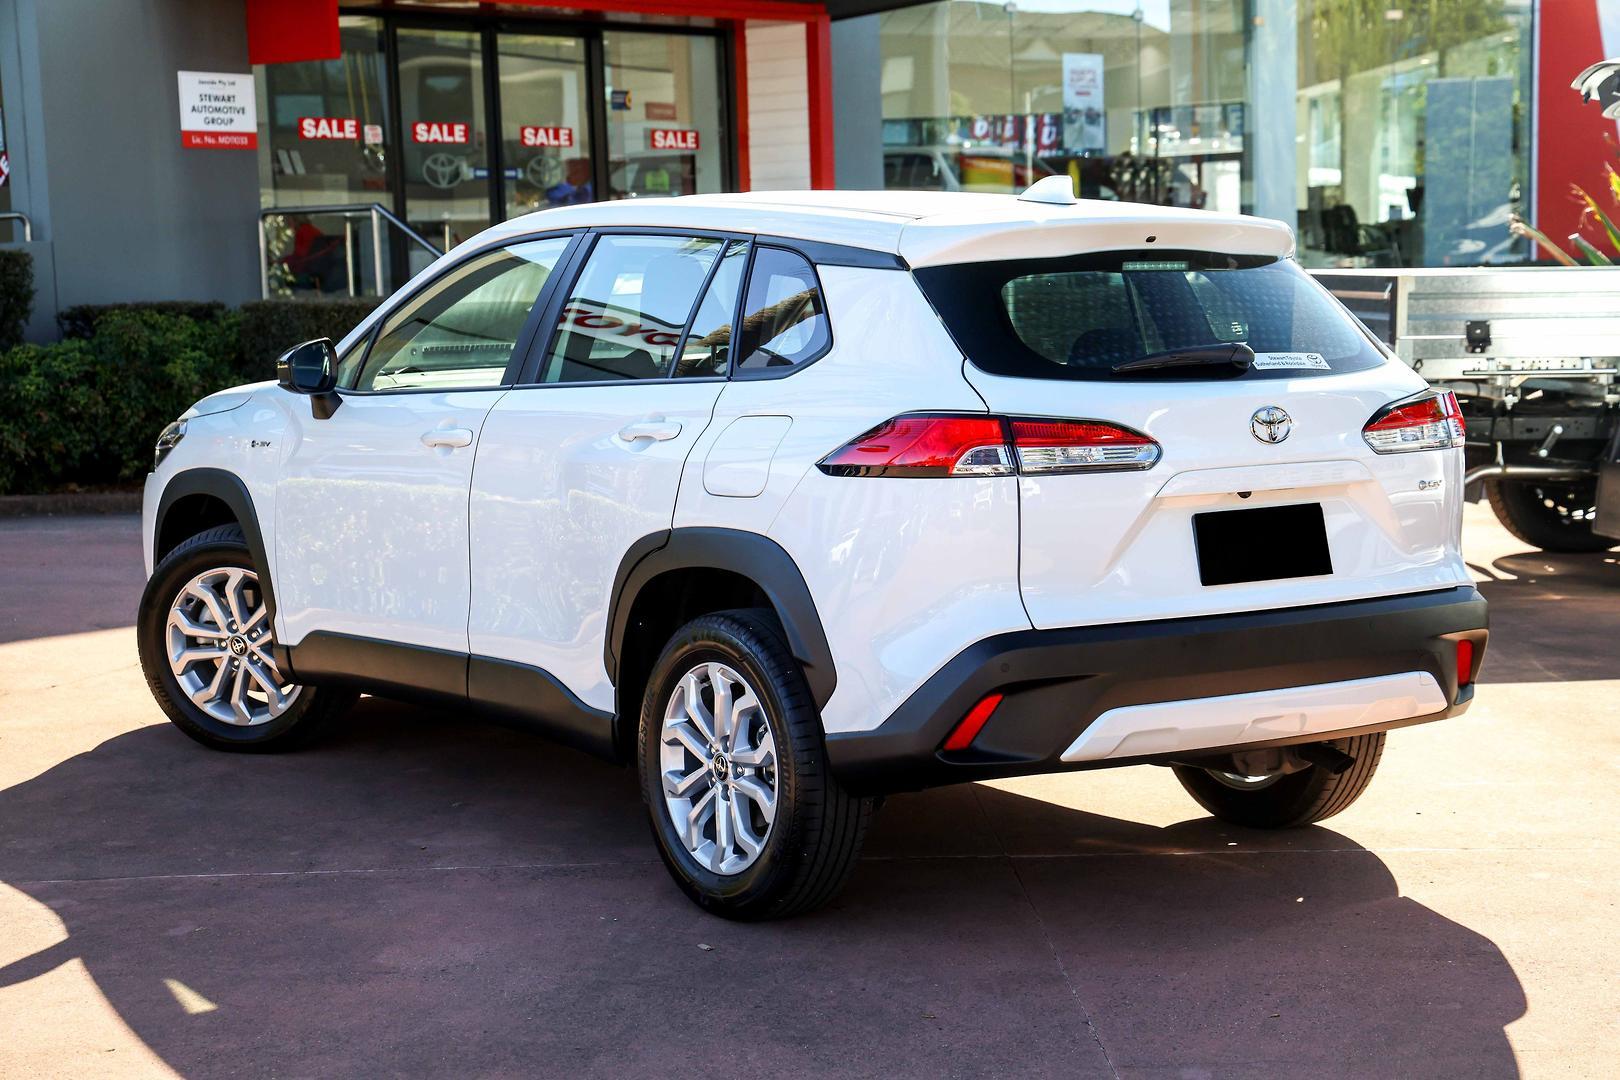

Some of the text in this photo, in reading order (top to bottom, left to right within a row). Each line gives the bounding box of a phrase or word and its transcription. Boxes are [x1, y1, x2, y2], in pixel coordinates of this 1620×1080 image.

[199, 94, 236, 102] STEWART
[191, 105, 245, 115] AUTOMOTIVE
[203, 117, 235, 125] GROUP
[302, 118, 357, 138] SALE
[415, 123, 466, 143] SALE
[523, 127, 570, 146] SALE
[654, 131, 697, 148] SALE
